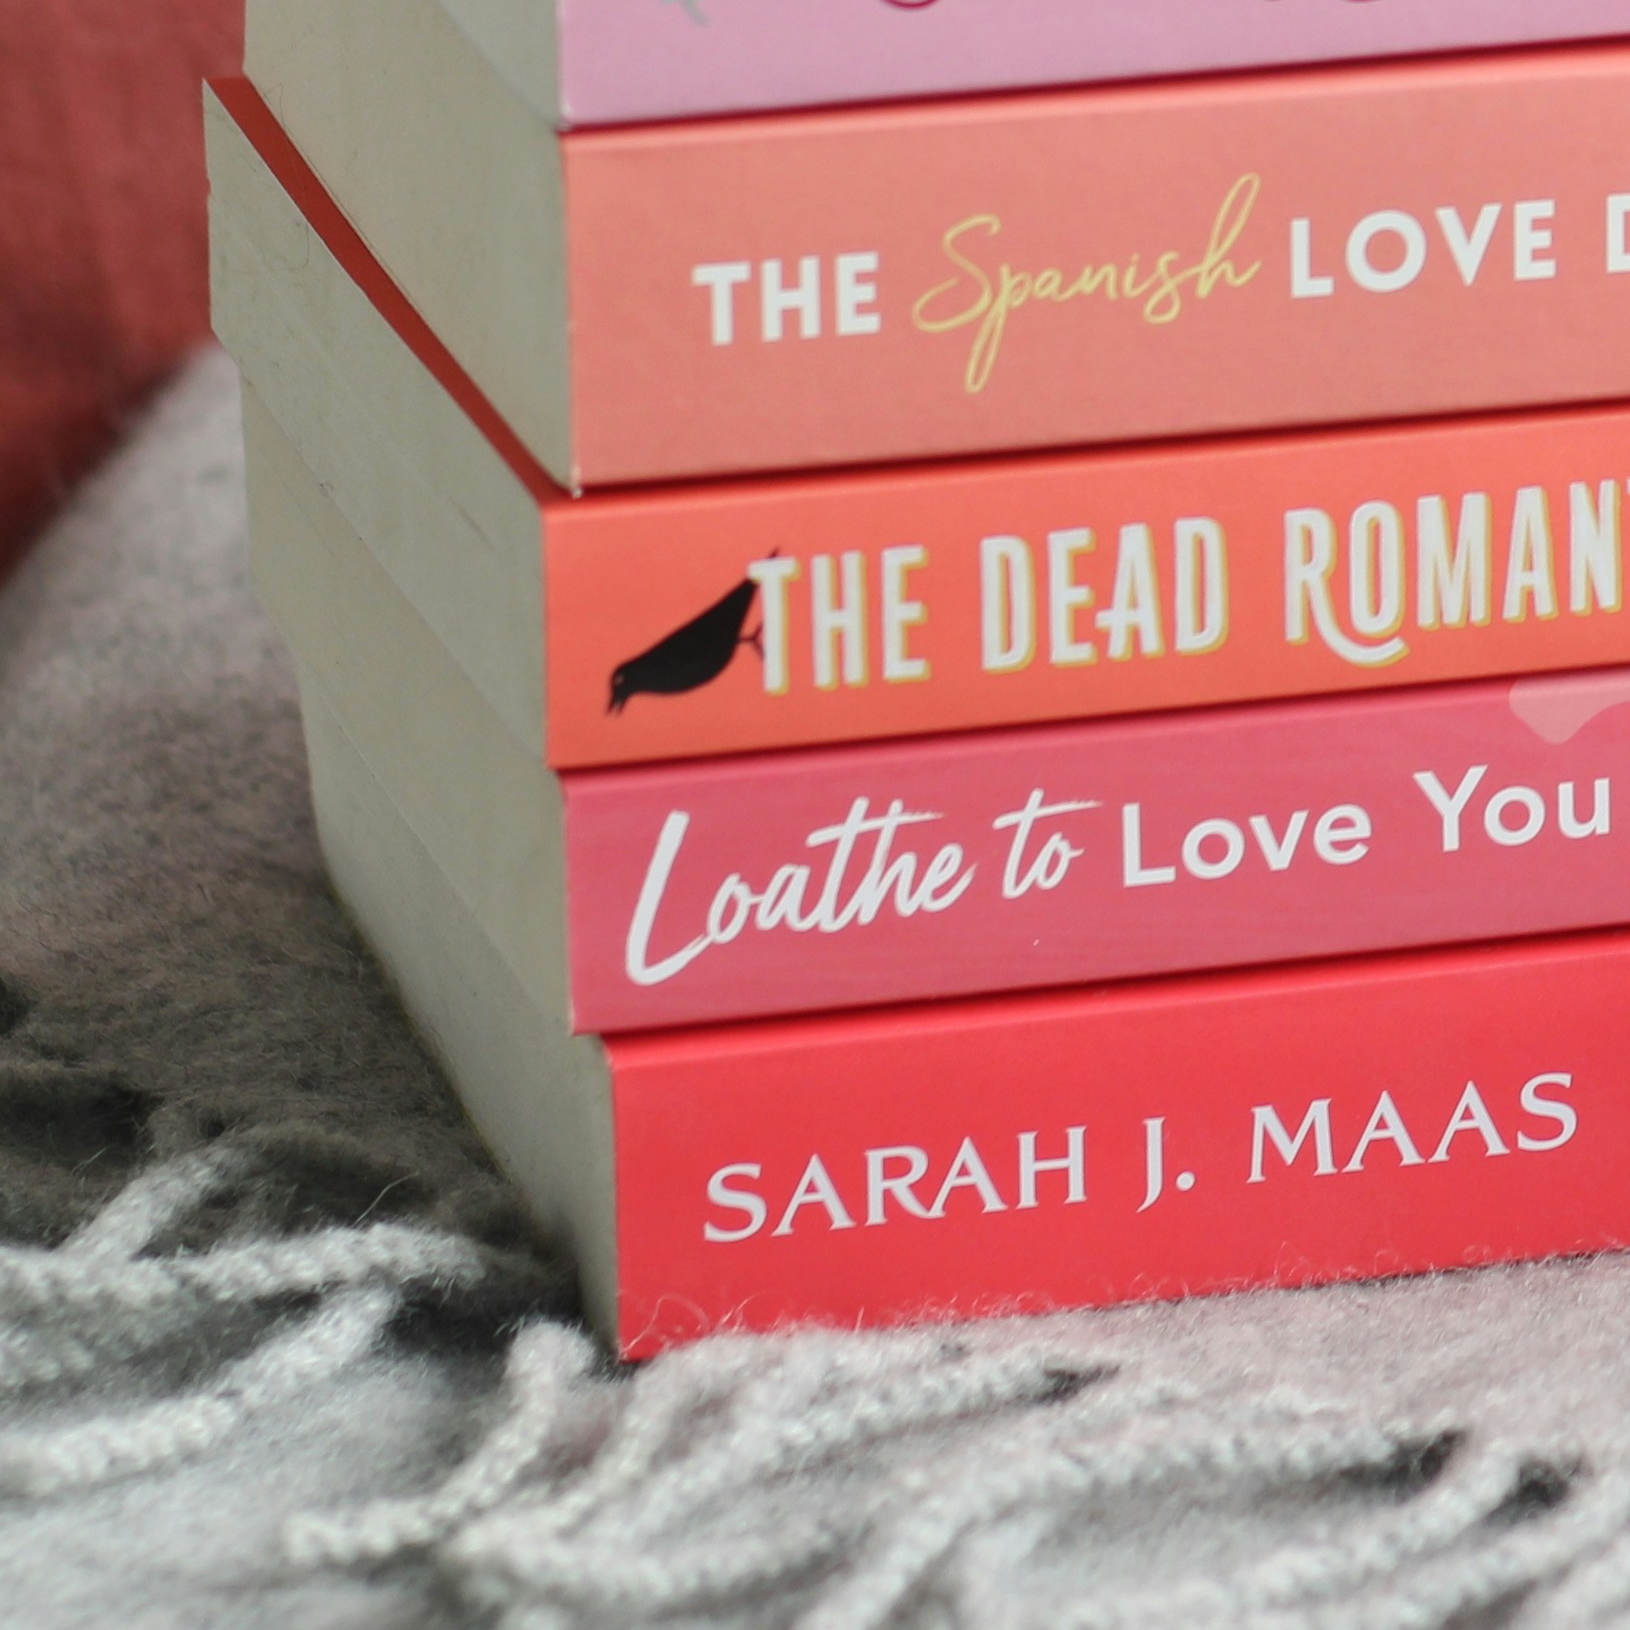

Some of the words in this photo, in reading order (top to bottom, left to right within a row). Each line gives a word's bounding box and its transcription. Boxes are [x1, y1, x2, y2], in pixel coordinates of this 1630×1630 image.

[691, 251, 882, 346] THE
[911, 172, 1262, 394] Spanish
[1290, 199, 1557, 300] LOVE
[747, 544, 930, 695] THE
[979, 515, 1227, 673] DEAD
[624, 795, 978, 987] Loathe
[992, 787, 1104, 899] to
[1121, 800, 1373, 889] Love
[1413, 764, 1611, 854] You
[703, 1125, 1089, 1245] SARAH
[1137, 1115, 1198, 1214] J.
[1246, 1071, 1580, 1185] MAAS
